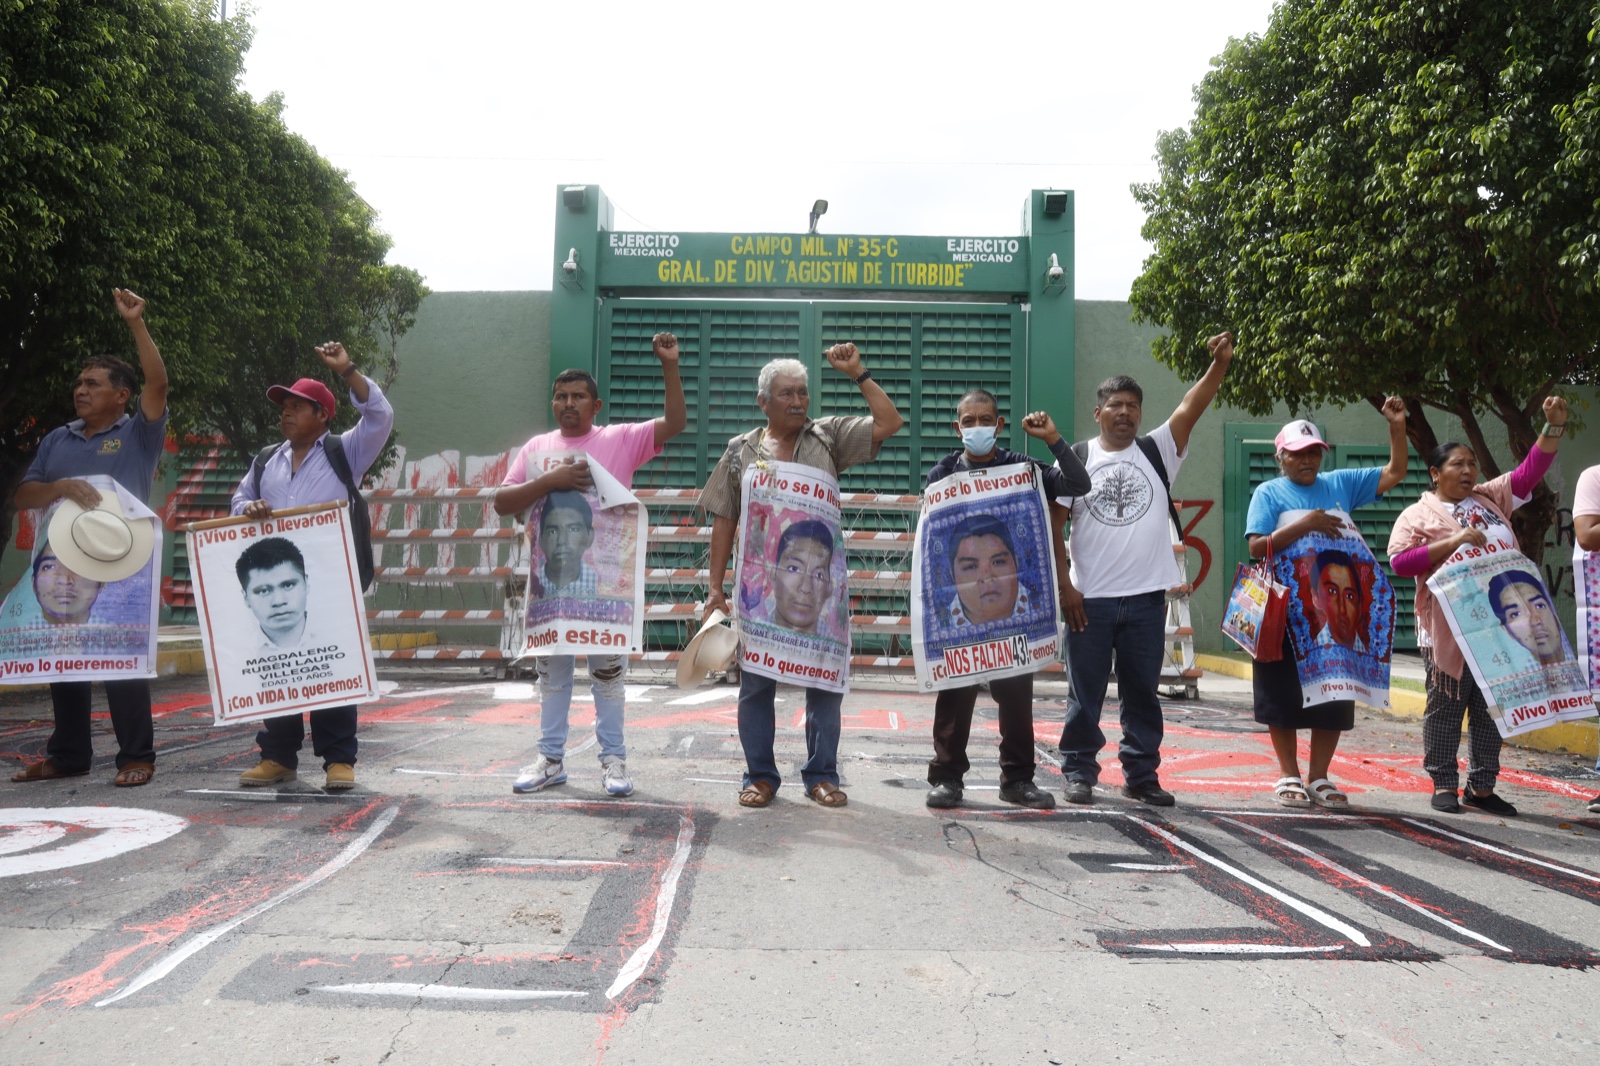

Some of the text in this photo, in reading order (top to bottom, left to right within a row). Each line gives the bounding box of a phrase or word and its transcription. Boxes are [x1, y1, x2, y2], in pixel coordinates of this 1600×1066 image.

[609, 234, 680, 248] EJERCITO
[731, 236, 792, 256] CAMPO
[800, 237, 832, 257] MIL.
[859, 238, 899, 257] 35-C
[947, 239, 1019, 253] EJERCITO
[614, 248, 674, 257] MEXICANO
[953, 253, 1013, 263] MEXICANO
[658, 260, 710, 283] GRAL.
[715, 260, 737, 283] DE
[745, 260, 777, 283] DIV.
[864, 262, 882, 285] DE
[753, 472, 789, 490] ¡Vivo
[792, 481, 810, 495] se
[813, 483, 824, 499] lo
[944, 486, 957, 500] se
[960, 481, 972, 495] lo
[199, 511, 338, 548] ¡Vivo se lo llevaron!
[1465, 547, 1482, 559] se
[9, 602, 23, 618] 43
[1470, 605, 1488, 621] 43
[526, 628, 627, 650] Dónde están
[242, 652, 346, 675] RUBÉN LAURO
[246, 645, 338, 666] MAGDALENO
[763, 652, 775, 668] lo
[945, 635, 1030, 675] NOS FALTAN 43!
[1492, 650, 1511, 666] 43
[38, 659, 51, 672] lo
[55, 657, 139, 674] queremos!
[260, 663, 330, 680] VILLEGAS
[261, 679, 288, 688] EDAD
[306, 670, 334, 681] AÑOS
[1345, 682, 1353, 691] lo
[228, 675, 363, 713] ¡Con VIDA lo queremos!
[1511, 704, 1547, 726] ¡Vivo
